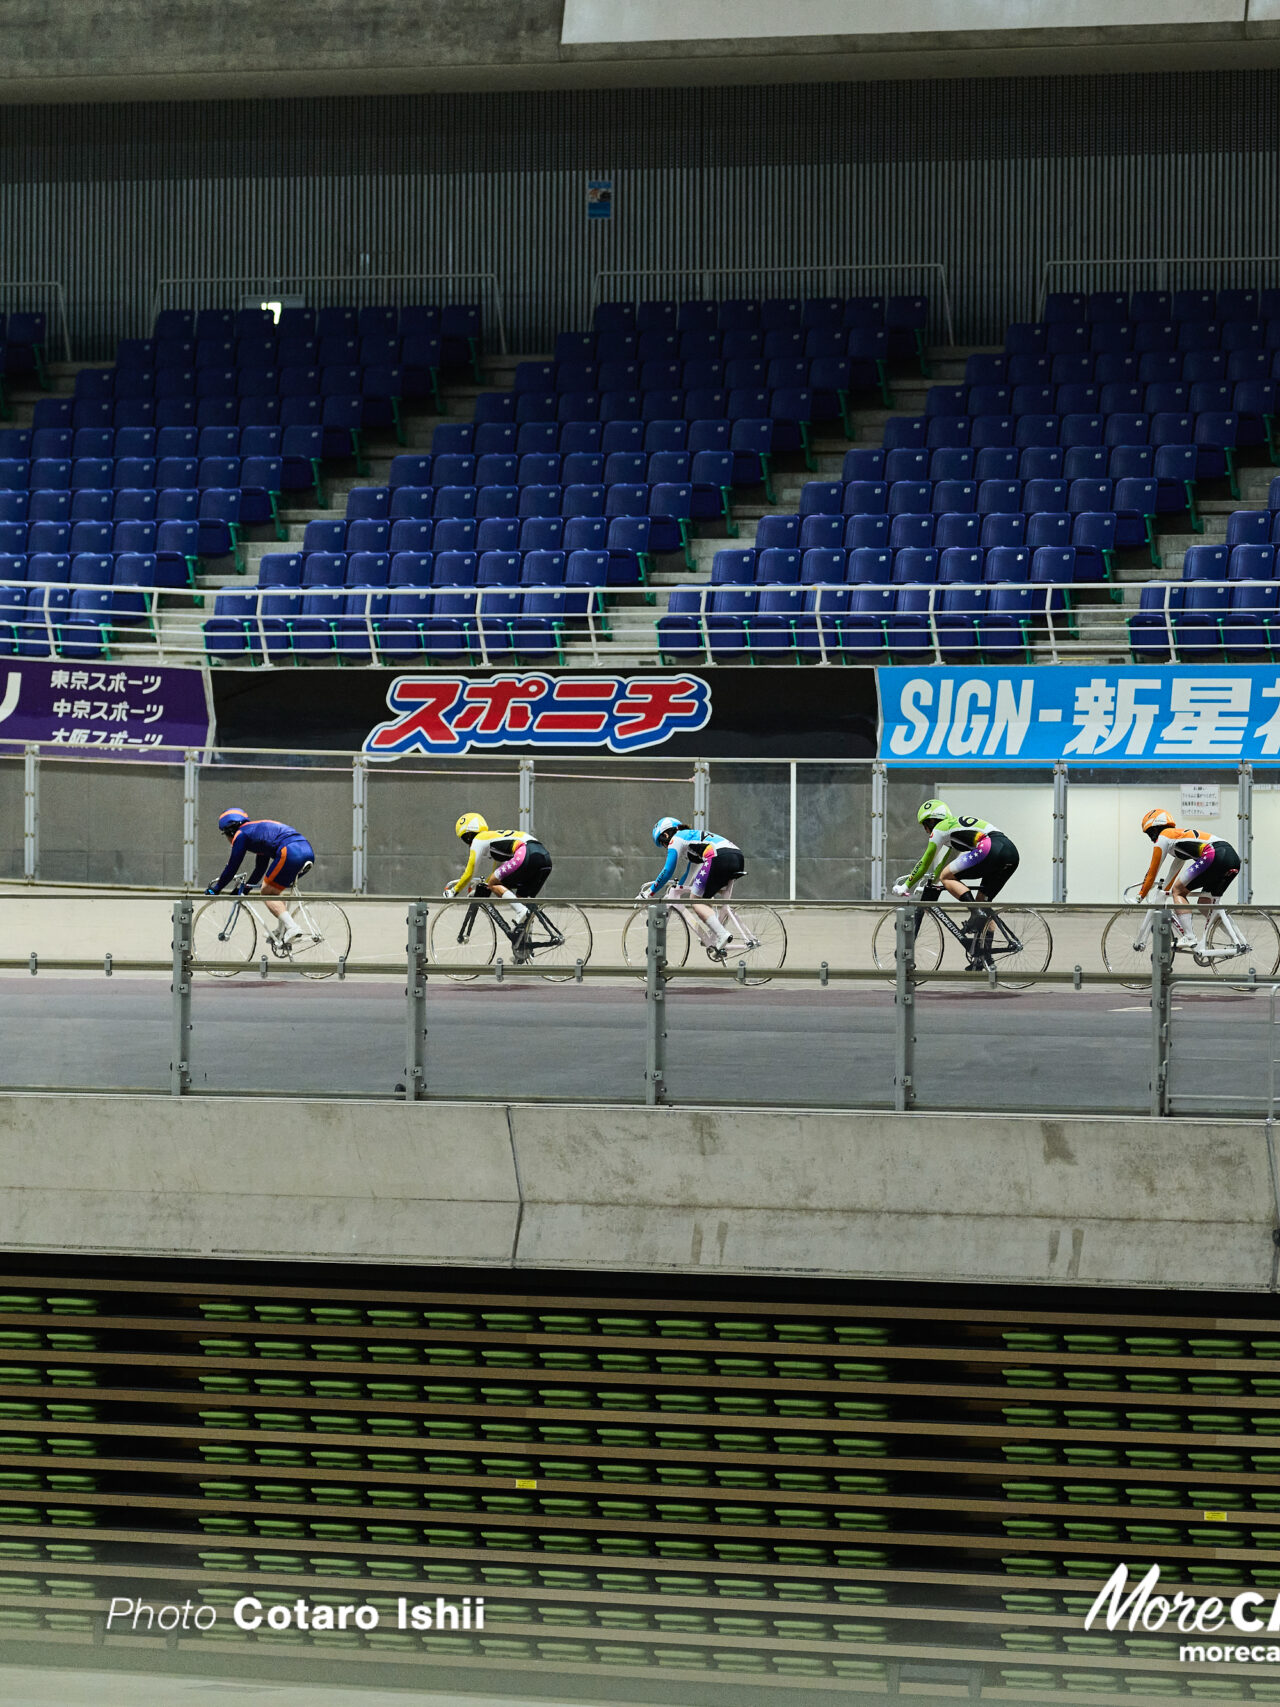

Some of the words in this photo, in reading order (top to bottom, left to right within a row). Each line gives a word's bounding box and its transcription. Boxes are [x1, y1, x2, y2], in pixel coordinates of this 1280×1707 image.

[50, 670, 162, 694] 東京スポーツ
[53, 698, 164, 724] 中京スポーツ
[362, 672, 712, 762] スポニチ
[51, 728, 163, 753] 大阪スポーツ
